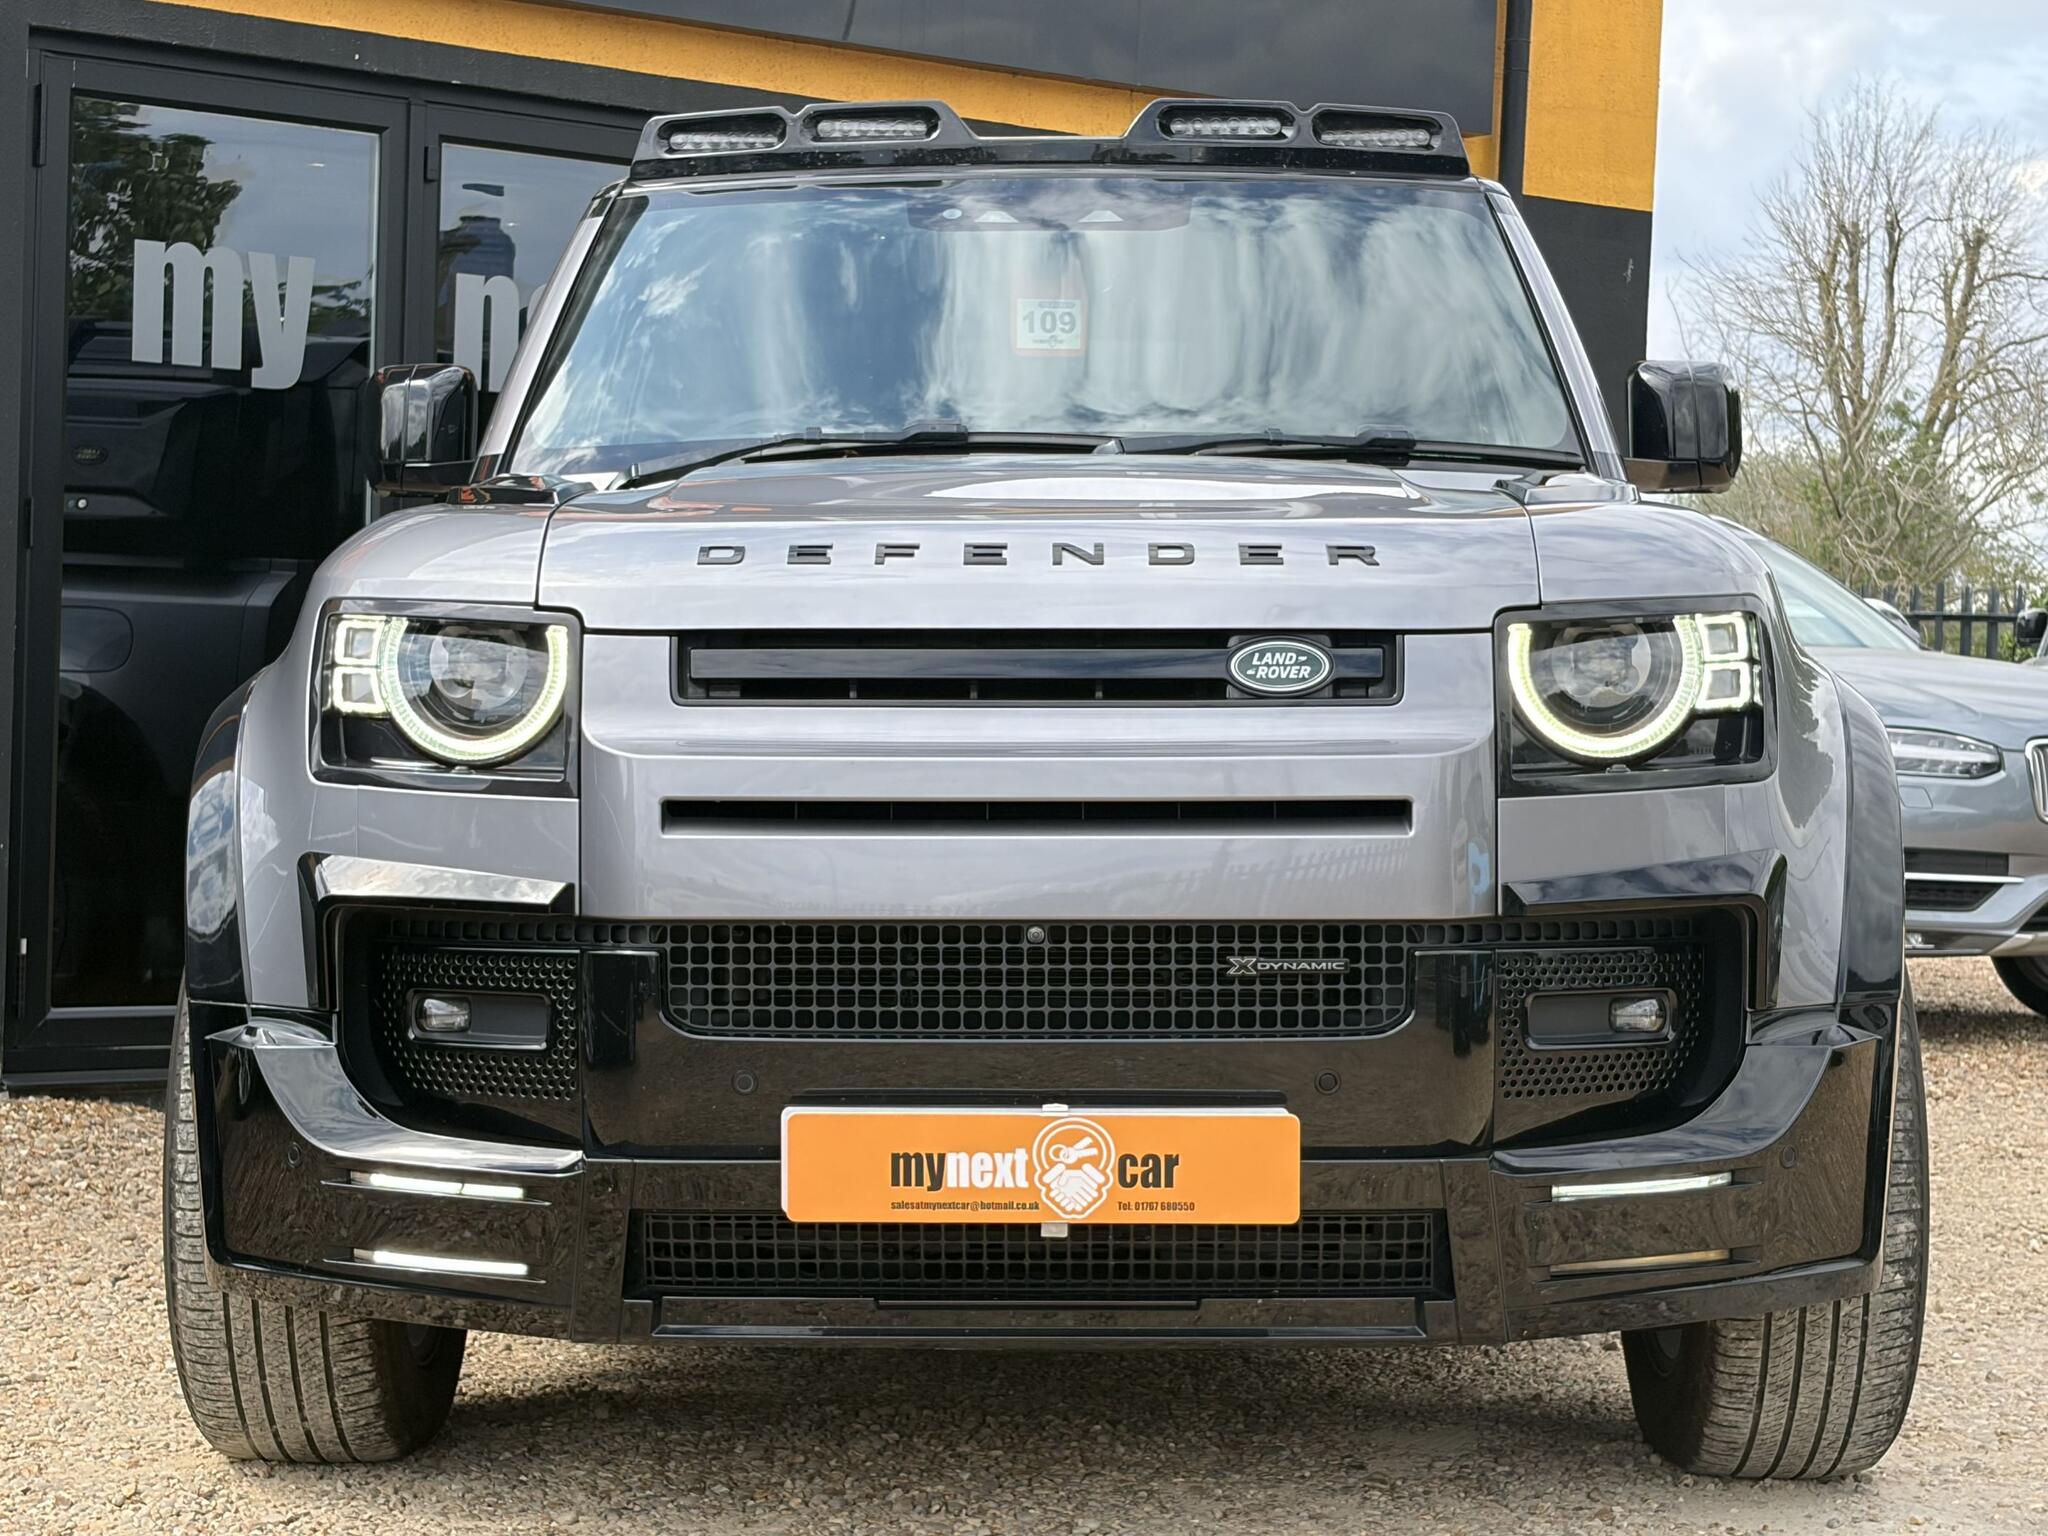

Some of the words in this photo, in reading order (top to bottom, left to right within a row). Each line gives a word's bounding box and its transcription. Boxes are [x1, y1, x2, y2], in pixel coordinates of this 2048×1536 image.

[132, 238, 316, 389] my
[453, 272, 548, 393] n
[1022, 310, 1077, 334] 109
[697, 542, 1381, 567] DEFENDER
[1252, 652, 1297, 665] LAND
[1255, 666, 1312, 679] ROVER
[1118, 1153, 1179, 1188] car
[1134, 1201, 1159, 1211] 01767
[1160, 1201, 1195, 1211] 680550
